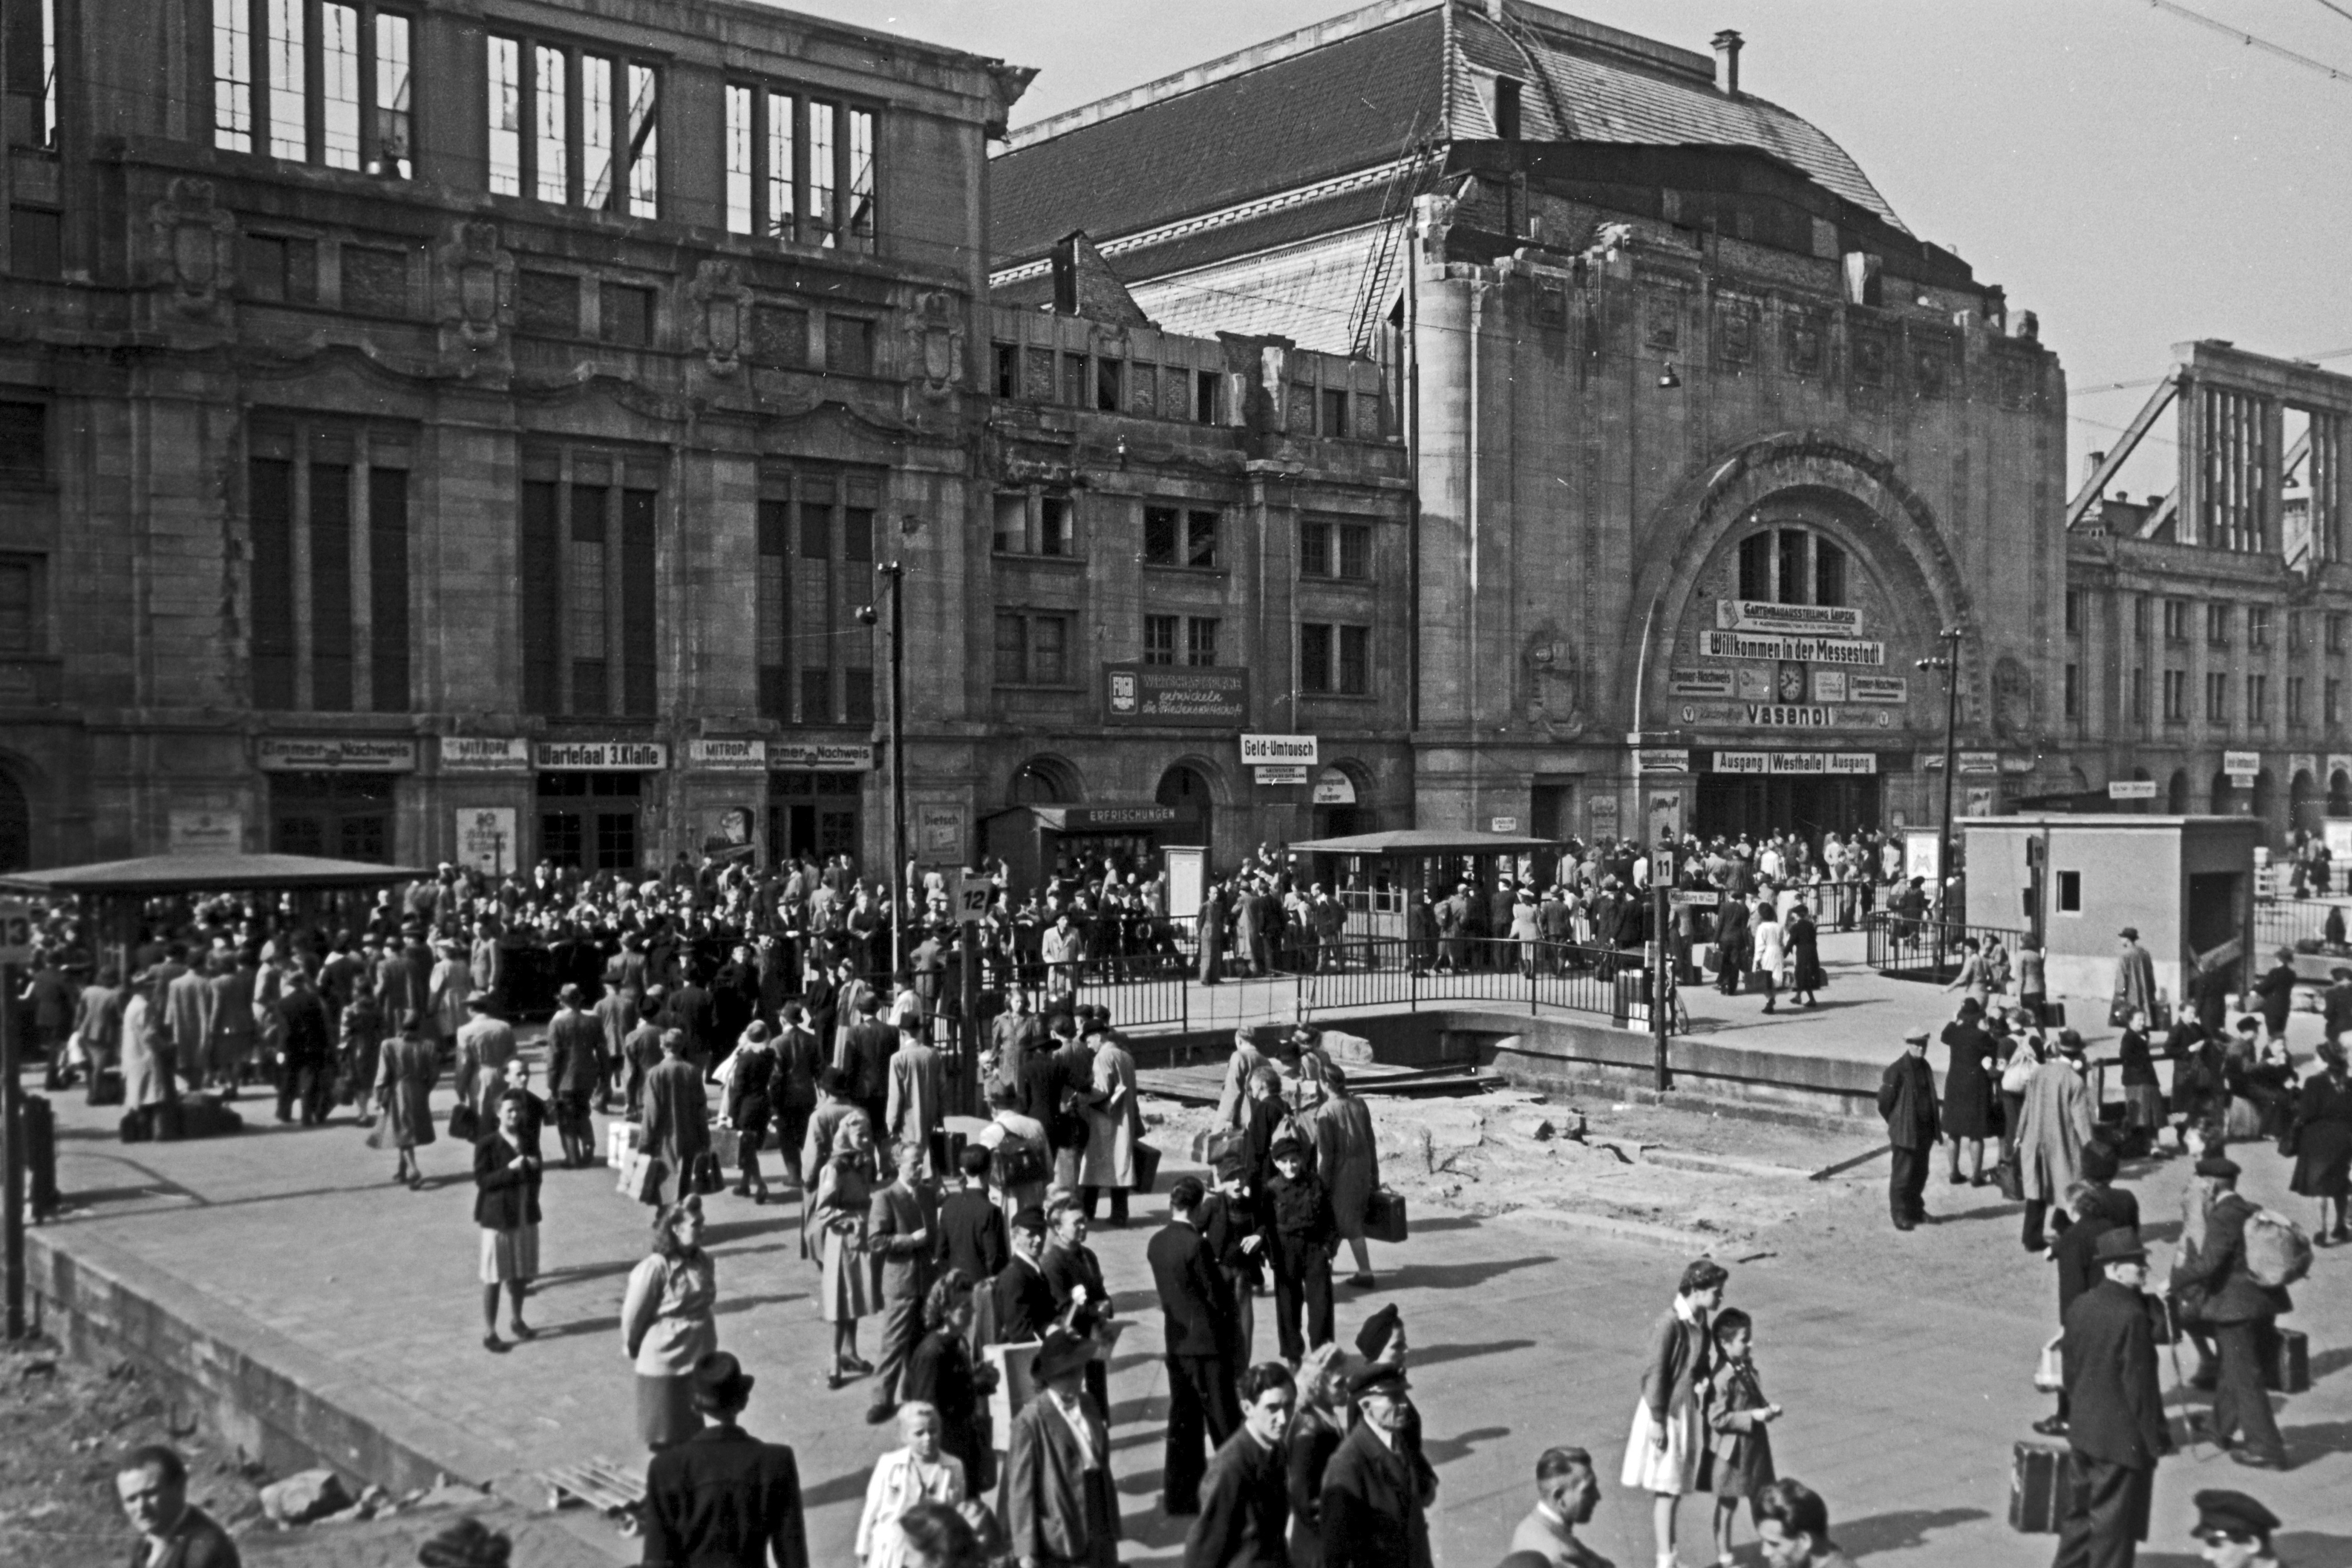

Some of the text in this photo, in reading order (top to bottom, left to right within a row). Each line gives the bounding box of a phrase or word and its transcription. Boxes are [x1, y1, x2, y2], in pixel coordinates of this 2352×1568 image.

[1710, 633, 1880, 663] Willkommen in der Messestadt
[1747, 704, 1832, 725] Vasenol
[706, 743, 750, 757] MITROPA
[769, 745, 870, 759] mmer-Nachweis
[1244, 740, 1314, 757] Geld-Umtausch
[1719, 752, 1763, 772] Ausgang
[1772, 753, 1822, 771] Westhalle
[1832, 754, 1870, 773] Ausgang
[1090, 808, 1175, 822] ERFRISCHUNGEN
[1657, 860, 1670, 877] 11
[963, 890, 986, 911] 12
